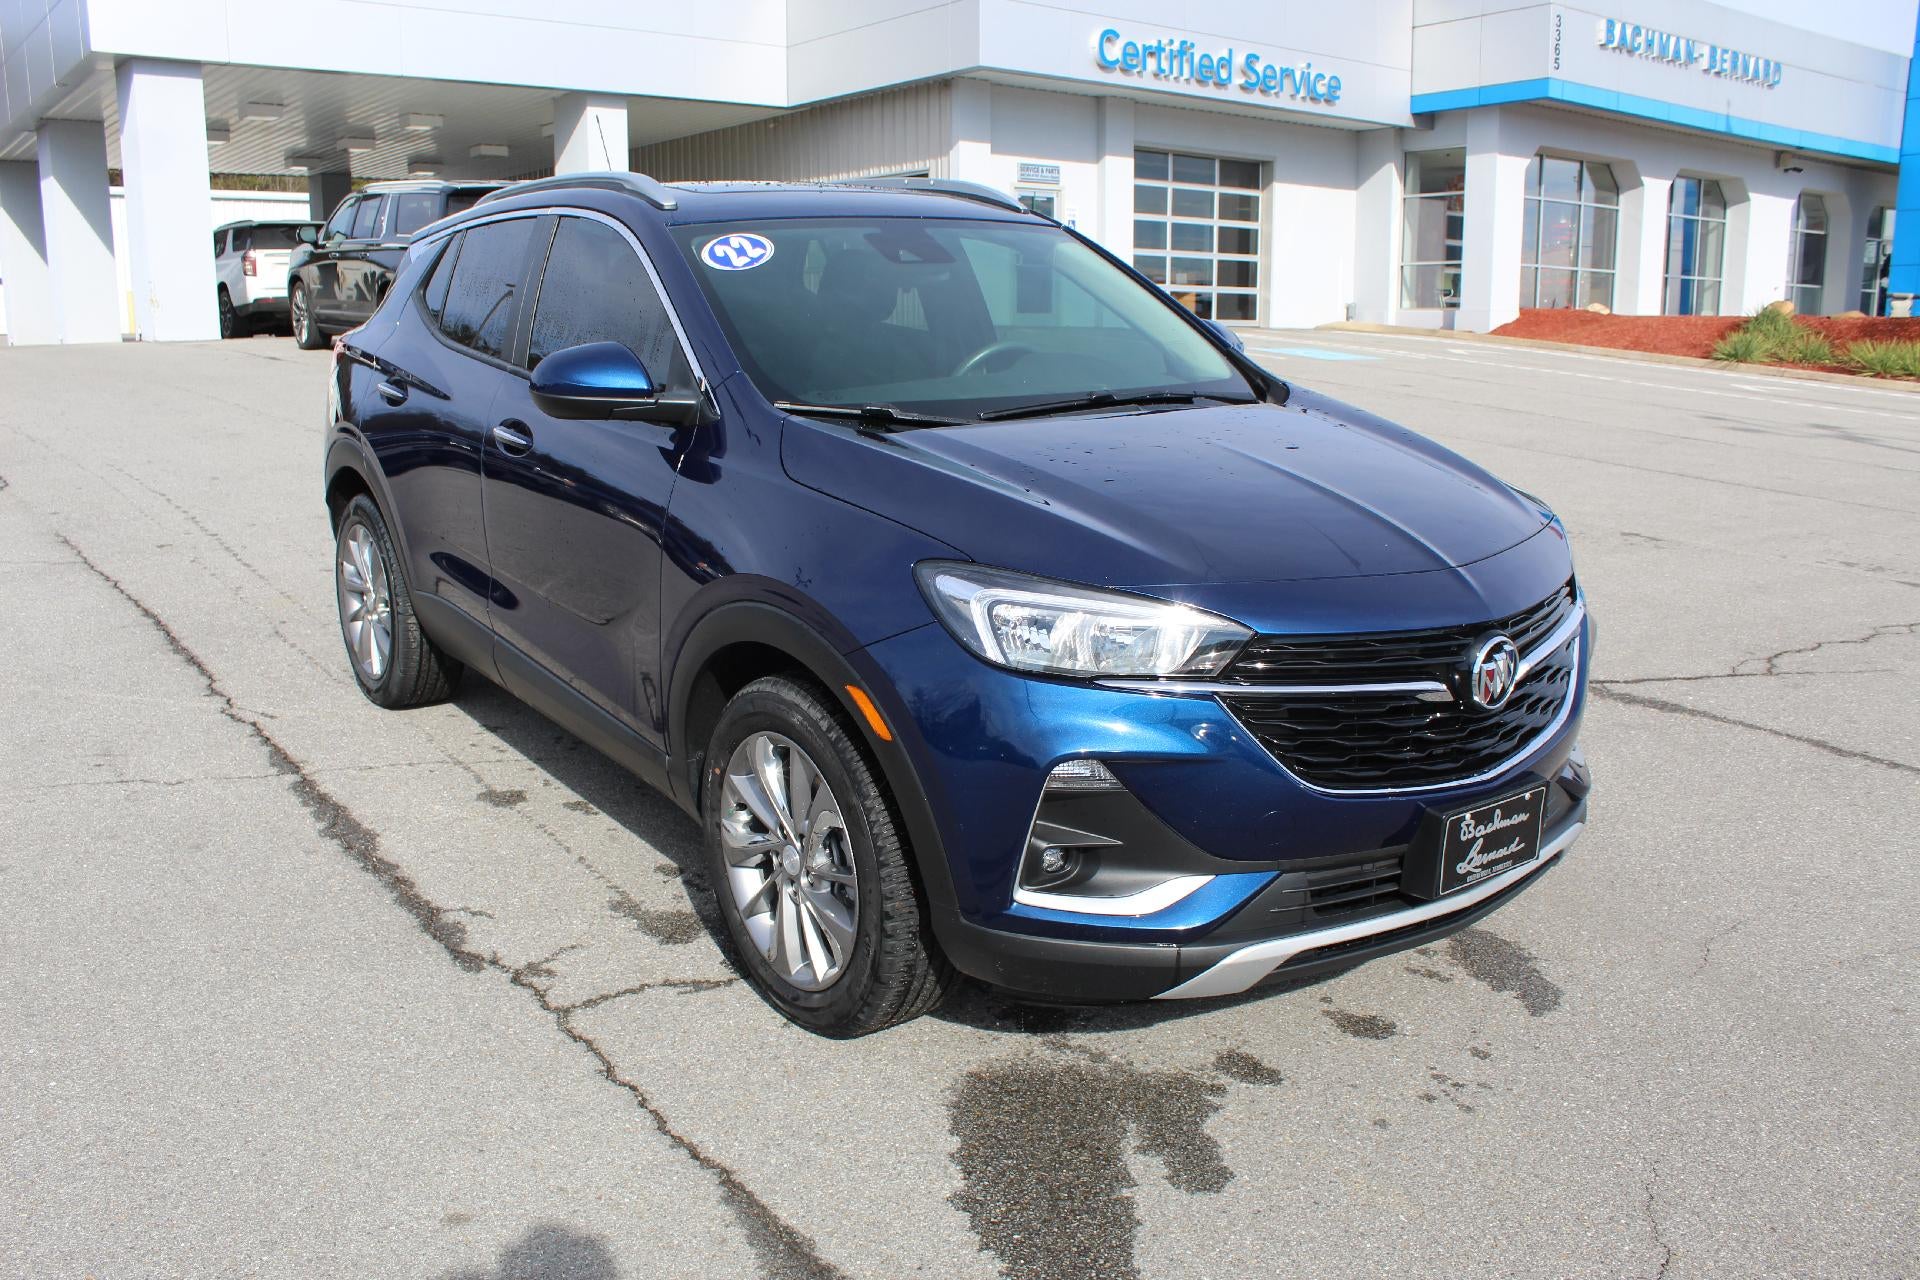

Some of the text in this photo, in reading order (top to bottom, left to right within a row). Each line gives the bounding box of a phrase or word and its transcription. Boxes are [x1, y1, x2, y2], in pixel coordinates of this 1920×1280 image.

[1554, 14, 1562, 70] 3365
[1097, 28, 1342, 101] Certified Service
[1020, 166, 1040, 174] SERVICE
[1045, 167, 1060, 175] PARTS
[713, 236, 767, 267] 22
[1460, 809, 1529, 841] Bachman
